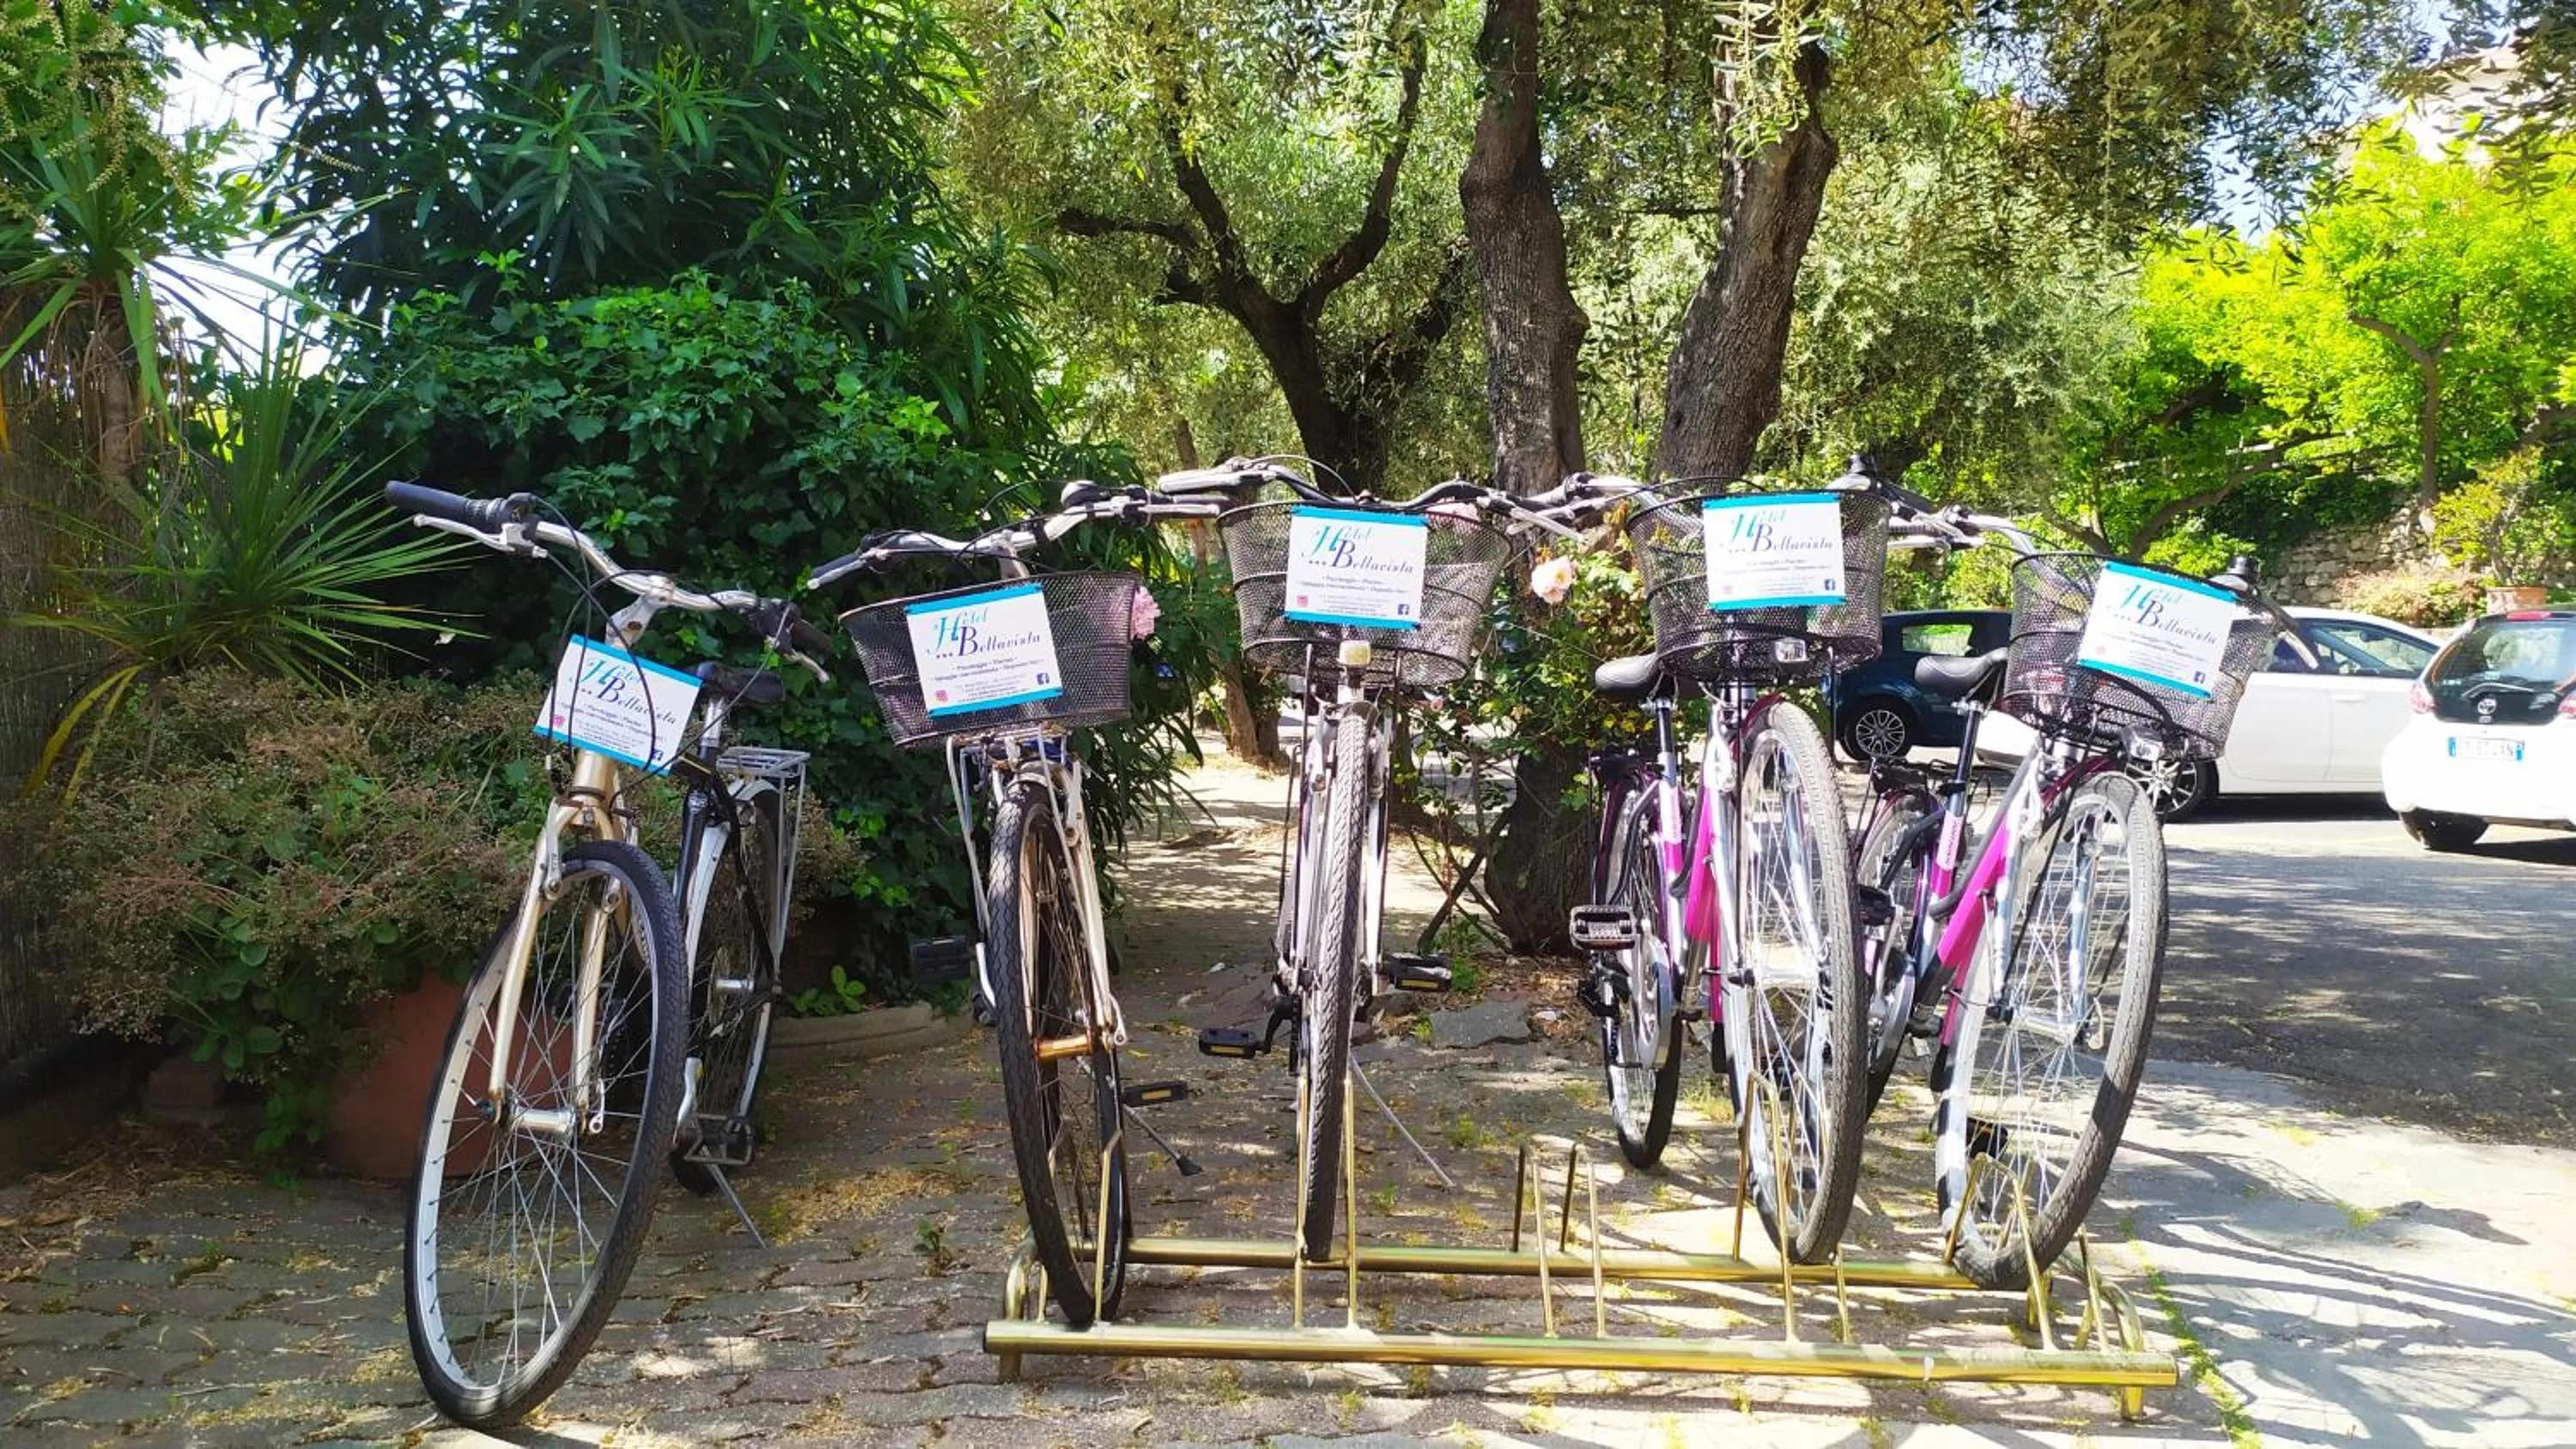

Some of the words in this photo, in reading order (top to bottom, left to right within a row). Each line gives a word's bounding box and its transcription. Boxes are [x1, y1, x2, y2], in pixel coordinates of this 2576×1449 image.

[1751, 524, 1833, 552] Bellavista
[1331, 539, 1413, 573] Bellavista
[2136, 600, 2217, 644] Bellavista
[957, 626, 1040, 657] Bellavista
